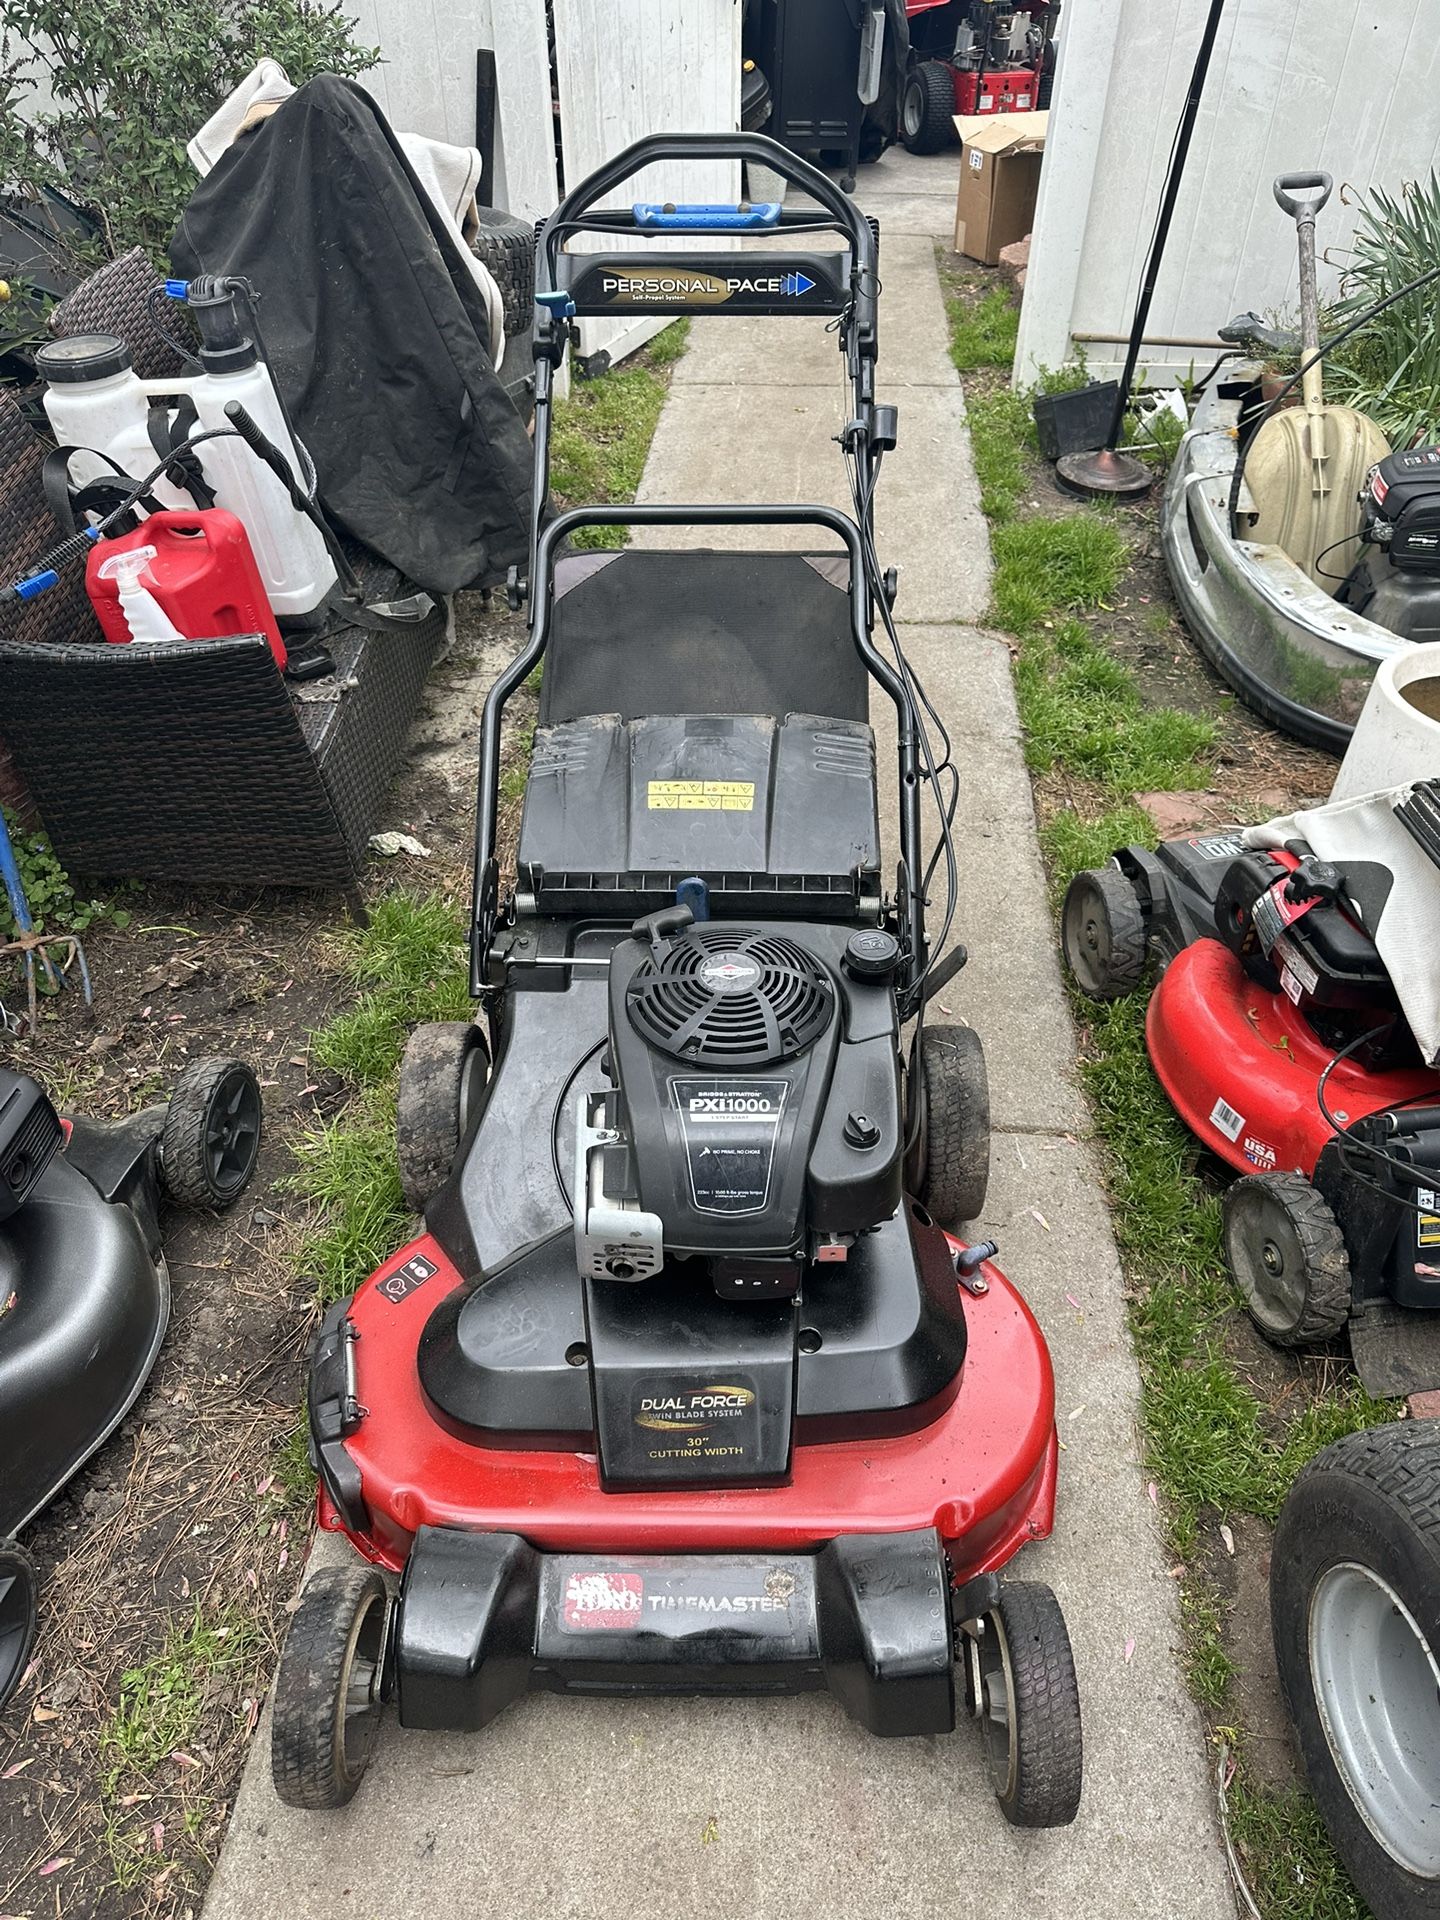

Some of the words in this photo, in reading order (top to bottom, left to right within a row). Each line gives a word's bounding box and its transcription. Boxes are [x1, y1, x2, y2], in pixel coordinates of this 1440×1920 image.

[603, 278, 718, 293] PERSONAL
[726, 278, 781, 293] PACE
[665, 294, 686, 302] System
[689, 1098, 771, 1112] PXi1000
[1244, 1137, 1276, 1164] USA
[640, 1398, 685, 1411] DUAL
[691, 1394, 748, 1409] FORCE
[648, 1411, 672, 1420] TWIN
[675, 1410, 705, 1419] BLADE
[707, 1409, 743, 1418] SYSTEM
[649, 1448, 701, 1459] CUTTING
[705, 1446, 743, 1456] WIDTH
